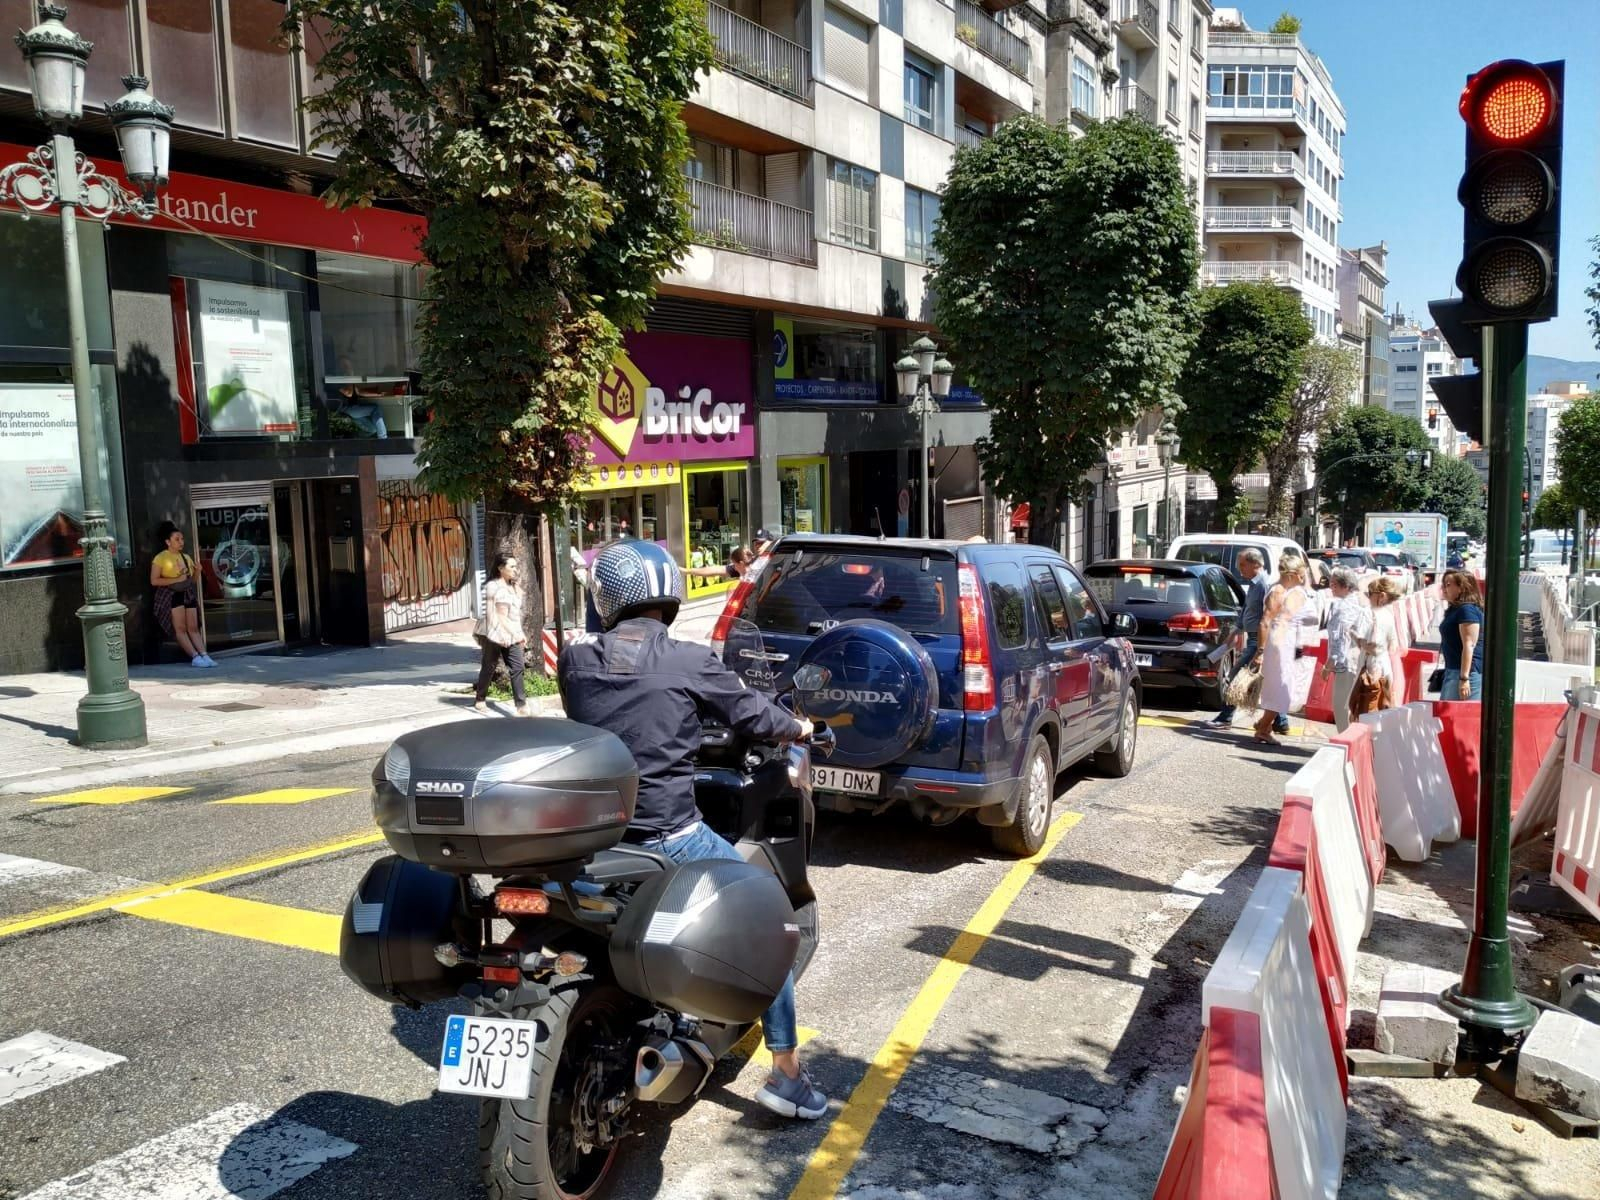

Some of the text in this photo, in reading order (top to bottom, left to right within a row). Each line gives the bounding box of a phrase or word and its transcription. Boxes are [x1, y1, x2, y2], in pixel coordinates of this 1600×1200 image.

[154, 191, 258, 229] tander
[643, 385, 745, 435] BriCor
[196, 504, 267, 527] HUBLOT
[813, 688, 899, 704] HONDA
[415, 781, 465, 793] SHAD
[842, 771, 875, 792] DNX
[448, 1046, 458, 1058] E
[466, 1024, 530, 1058] 5235
[458, 1056, 507, 1089] JNJ
